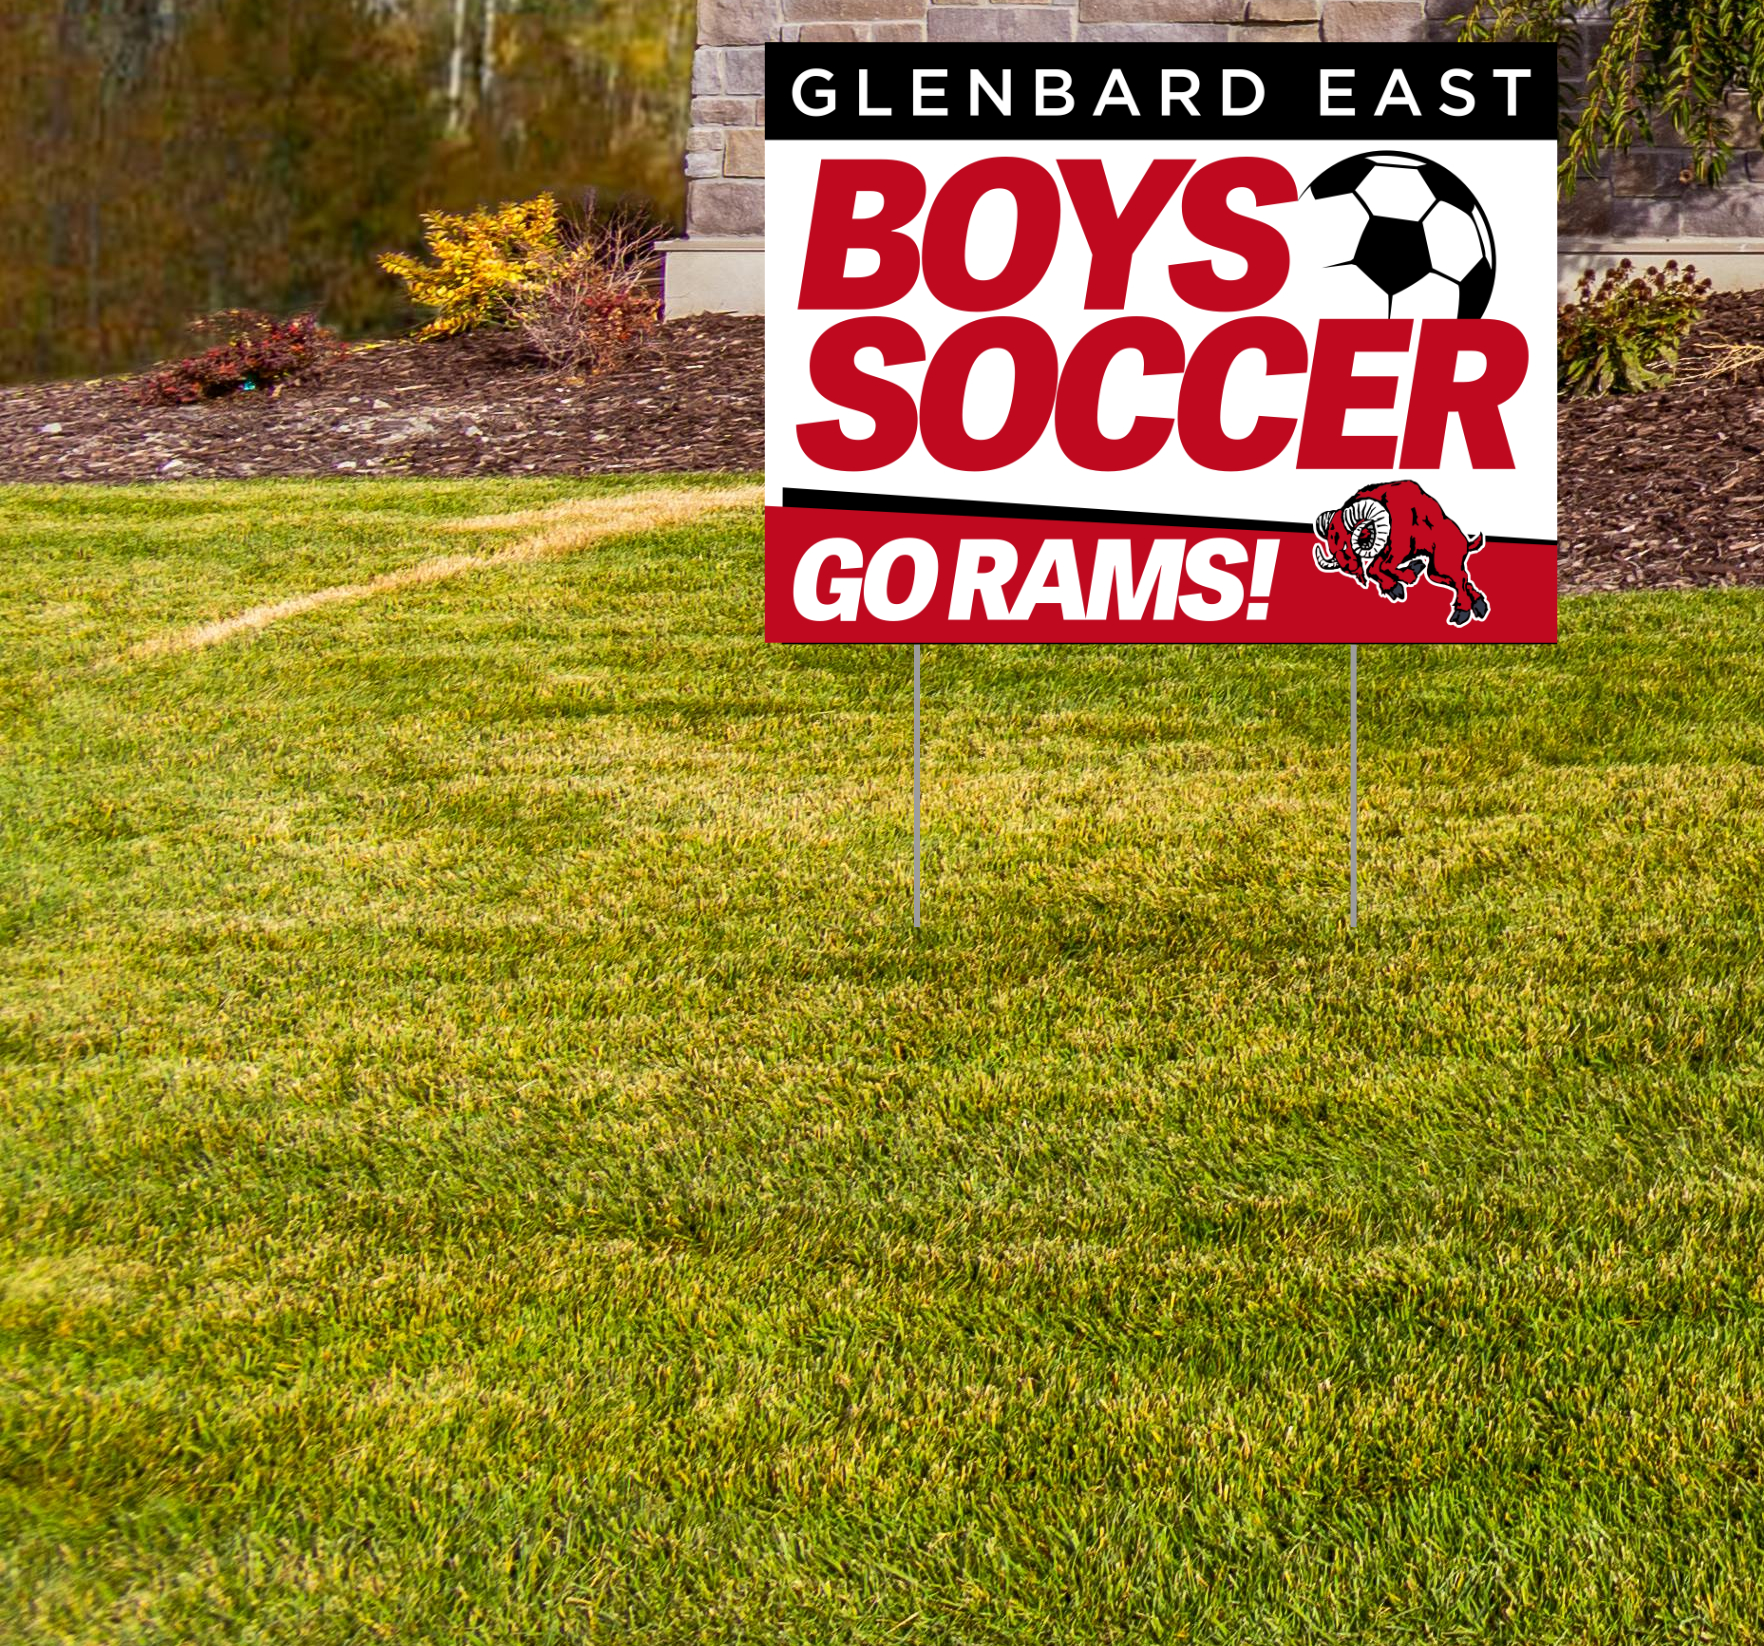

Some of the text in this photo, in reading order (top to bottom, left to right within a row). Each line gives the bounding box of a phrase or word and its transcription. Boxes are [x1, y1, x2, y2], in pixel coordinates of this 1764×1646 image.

[791, 67, 1533, 117] GLENBARD EAST
[797, 156, 1300, 313] BOYS
[795, 316, 1531, 472] SOCCER
[792, 537, 1280, 623] GO RAMS!
